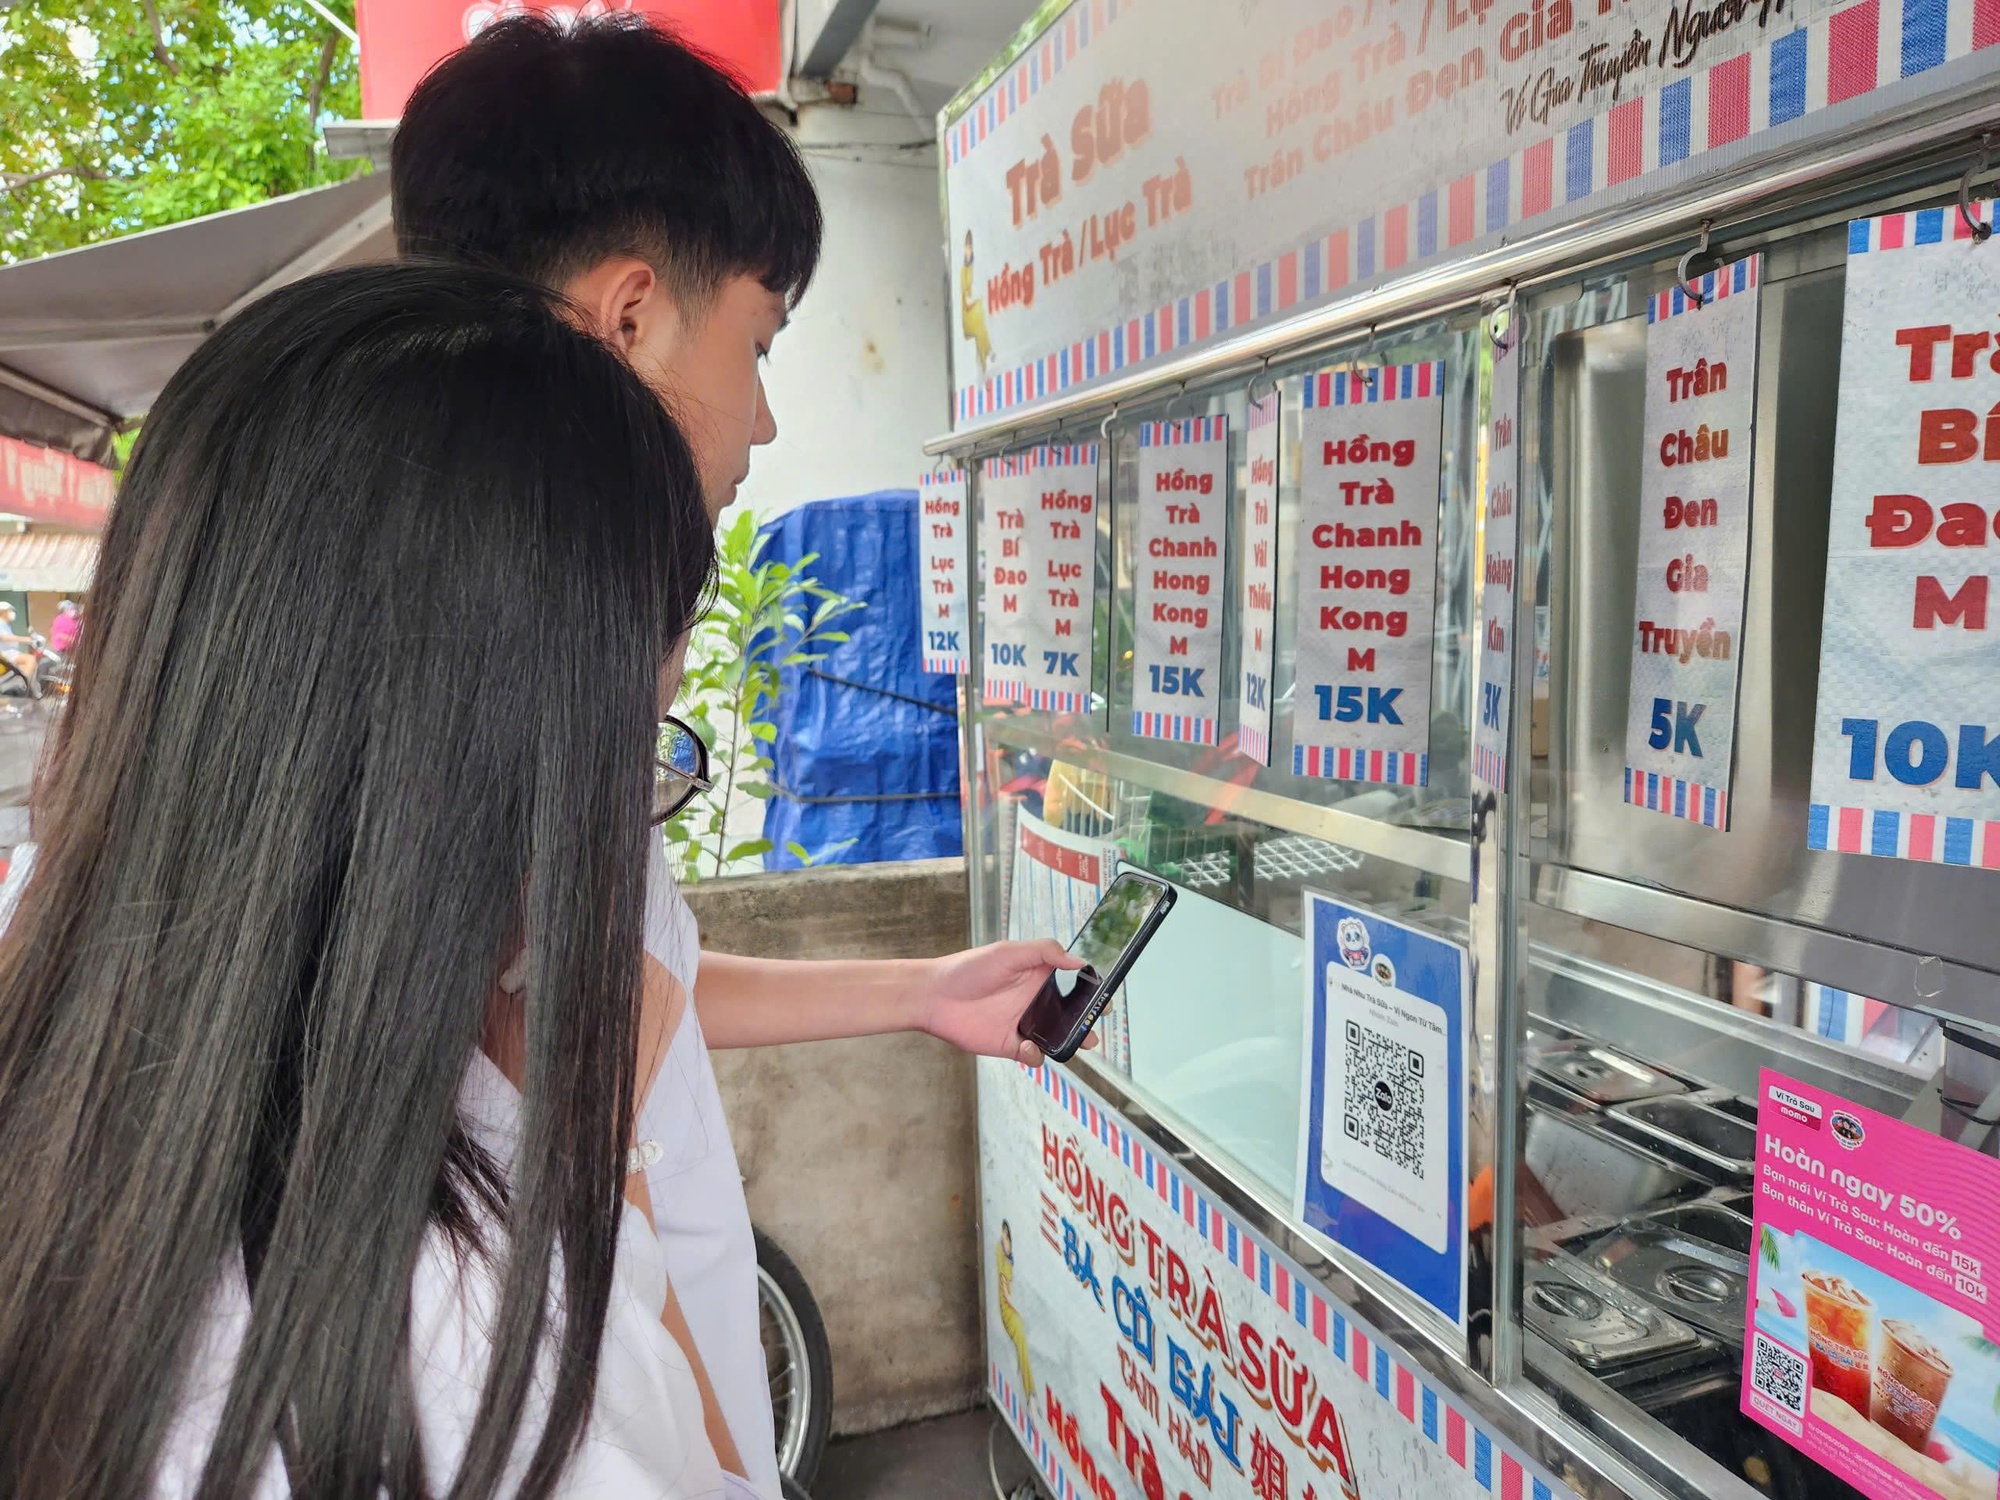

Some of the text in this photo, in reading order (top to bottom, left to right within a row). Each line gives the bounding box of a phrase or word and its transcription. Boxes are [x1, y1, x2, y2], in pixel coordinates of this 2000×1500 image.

[1313, 95, 1395, 163] Châu
[1006, 78, 1151, 228] Trà Sữa
[988, 262, 1034, 315] Hồng
[1040, 229, 1074, 286] Trà
[1142, 156, 1192, 228] Trà
[1896, 313, 2000, 383] Tr
[1666, 357, 1728, 404] Trân
[1323, 433, 1416, 467] Hồng
[1660, 424, 1729, 467] Châu
[1156, 468, 1213, 494] Hồng
[1339, 477, 1395, 506] Trà
[1041, 489, 1092, 514] Hồng
[1166, 503, 1200, 524] Trà
[1255, 498, 1268, 525] Trà
[1663, 496, 1718, 529] Đen
[932, 522, 953, 538] Trà
[997, 508, 1025, 529] Trà
[1050, 520, 1080, 539] Trà
[1865, 494, 2000, 548] Đa
[1003, 537, 1019, 557] Bí
[1149, 537, 1217, 558] Chanh
[1312, 520, 1422, 549] Chanh
[931, 555, 955, 574] Lục
[994, 567, 1027, 585] Đao
[1048, 560, 1082, 582] Lục
[1666, 553, 1709, 593] Gia
[933, 578, 954, 594] Trà
[1153, 570, 1210, 595] Hong
[1319, 565, 1411, 595] Hong
[938, 603, 950, 619] M
[1003, 595, 1017, 613] M
[1049, 589, 1079, 608] Trà
[1913, 575, 1988, 631] M
[1055, 619, 1071, 636] M
[1152, 603, 1208, 628] Kong
[1319, 606, 1409, 637] Kong
[928, 630, 960, 652] 12K
[1169, 636, 1188, 655] M
[1254, 627, 1262, 652] M
[1487, 616, 1505, 654] Kim
[1638, 617, 1731, 665] Truyền
[991, 643, 1027, 667] 10K
[1043, 650, 1079, 677] 7K
[1347, 647, 1376, 672] M
[1149, 665, 1206, 698] 15K
[1246, 672, 1266, 712] 12K
[1313, 684, 1405, 726] 15K
[1483, 682, 1502, 732] 3K
[1647, 696, 1706, 758] 5K
[1401, 1010, 1417, 1024] Ngon
[1375, 1087, 1392, 1105] Zalo
[1776, 1090, 1784, 1100] Ví
[1799, 1101, 1815, 1113] Sau
[1781, 1106, 1808, 1123] momo
[1765, 1133, 1962, 1240] Hoàn ngay 50%
[1763, 1163, 1978, 1276] Bạn mới Ví Trả Sau: Hoàn đến 15k
[1762, 1182, 1785, 1202] Bạn
[1787, 1194, 1814, 1217] thân
[1817, 1208, 1830, 1225] Ví
[1855, 1227, 1884, 1251] Sau:
[1887, 1243, 1923, 1270] Hoàn
[1926, 1264, 1953, 1285] đến
[1958, 1279, 1984, 1300] 10k
[1061, 1216, 1105, 1312] BA
[1112, 1275, 1155, 1373] CÔ
[1042, 1121, 1358, 1497] HỒNG TRÀ SỮA
